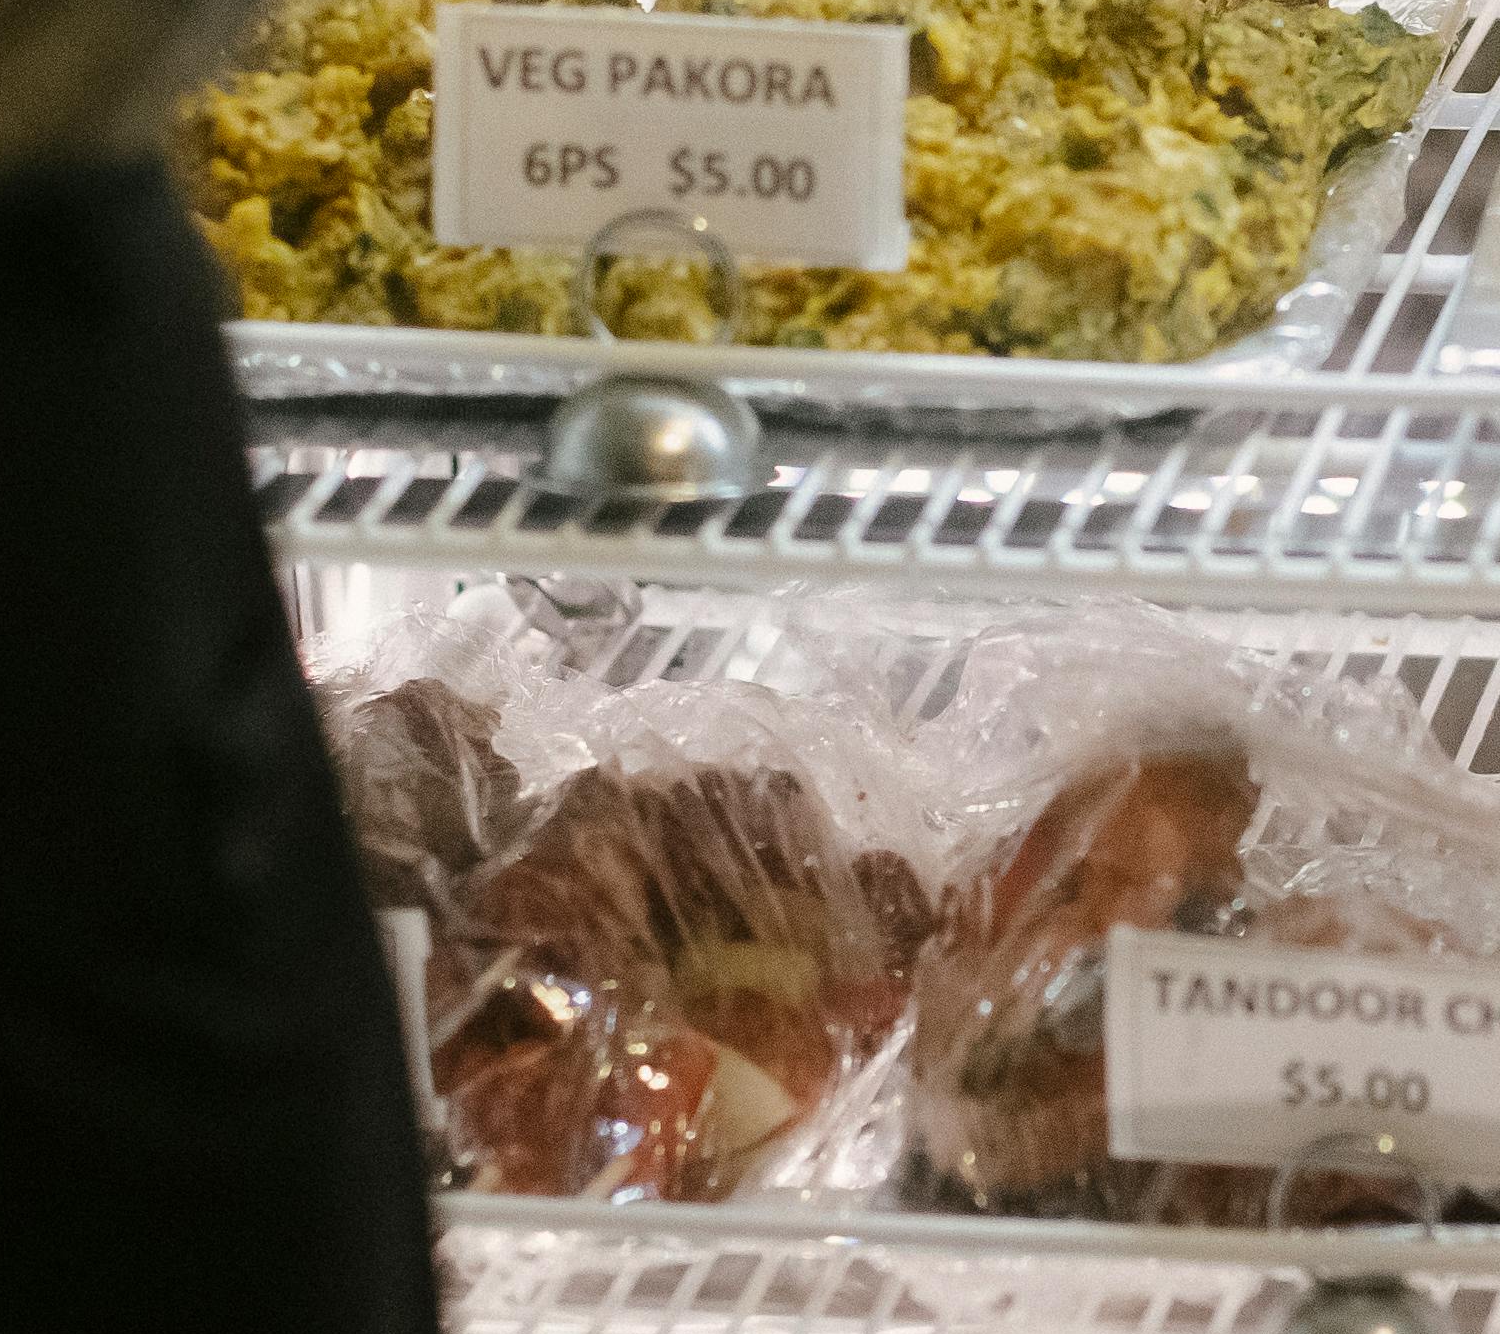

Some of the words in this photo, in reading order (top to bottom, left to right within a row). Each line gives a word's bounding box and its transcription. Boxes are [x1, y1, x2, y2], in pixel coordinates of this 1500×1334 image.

[476, 45, 586, 94] VEG
[606, 52, 838, 110] PAKORA
[523, 140, 620, 189] 6PS
[668, 143, 818, 203] $5.00
[1150, 969, 1428, 1031] TANDOOR
[1280, 1059, 1432, 1115] $5.00
